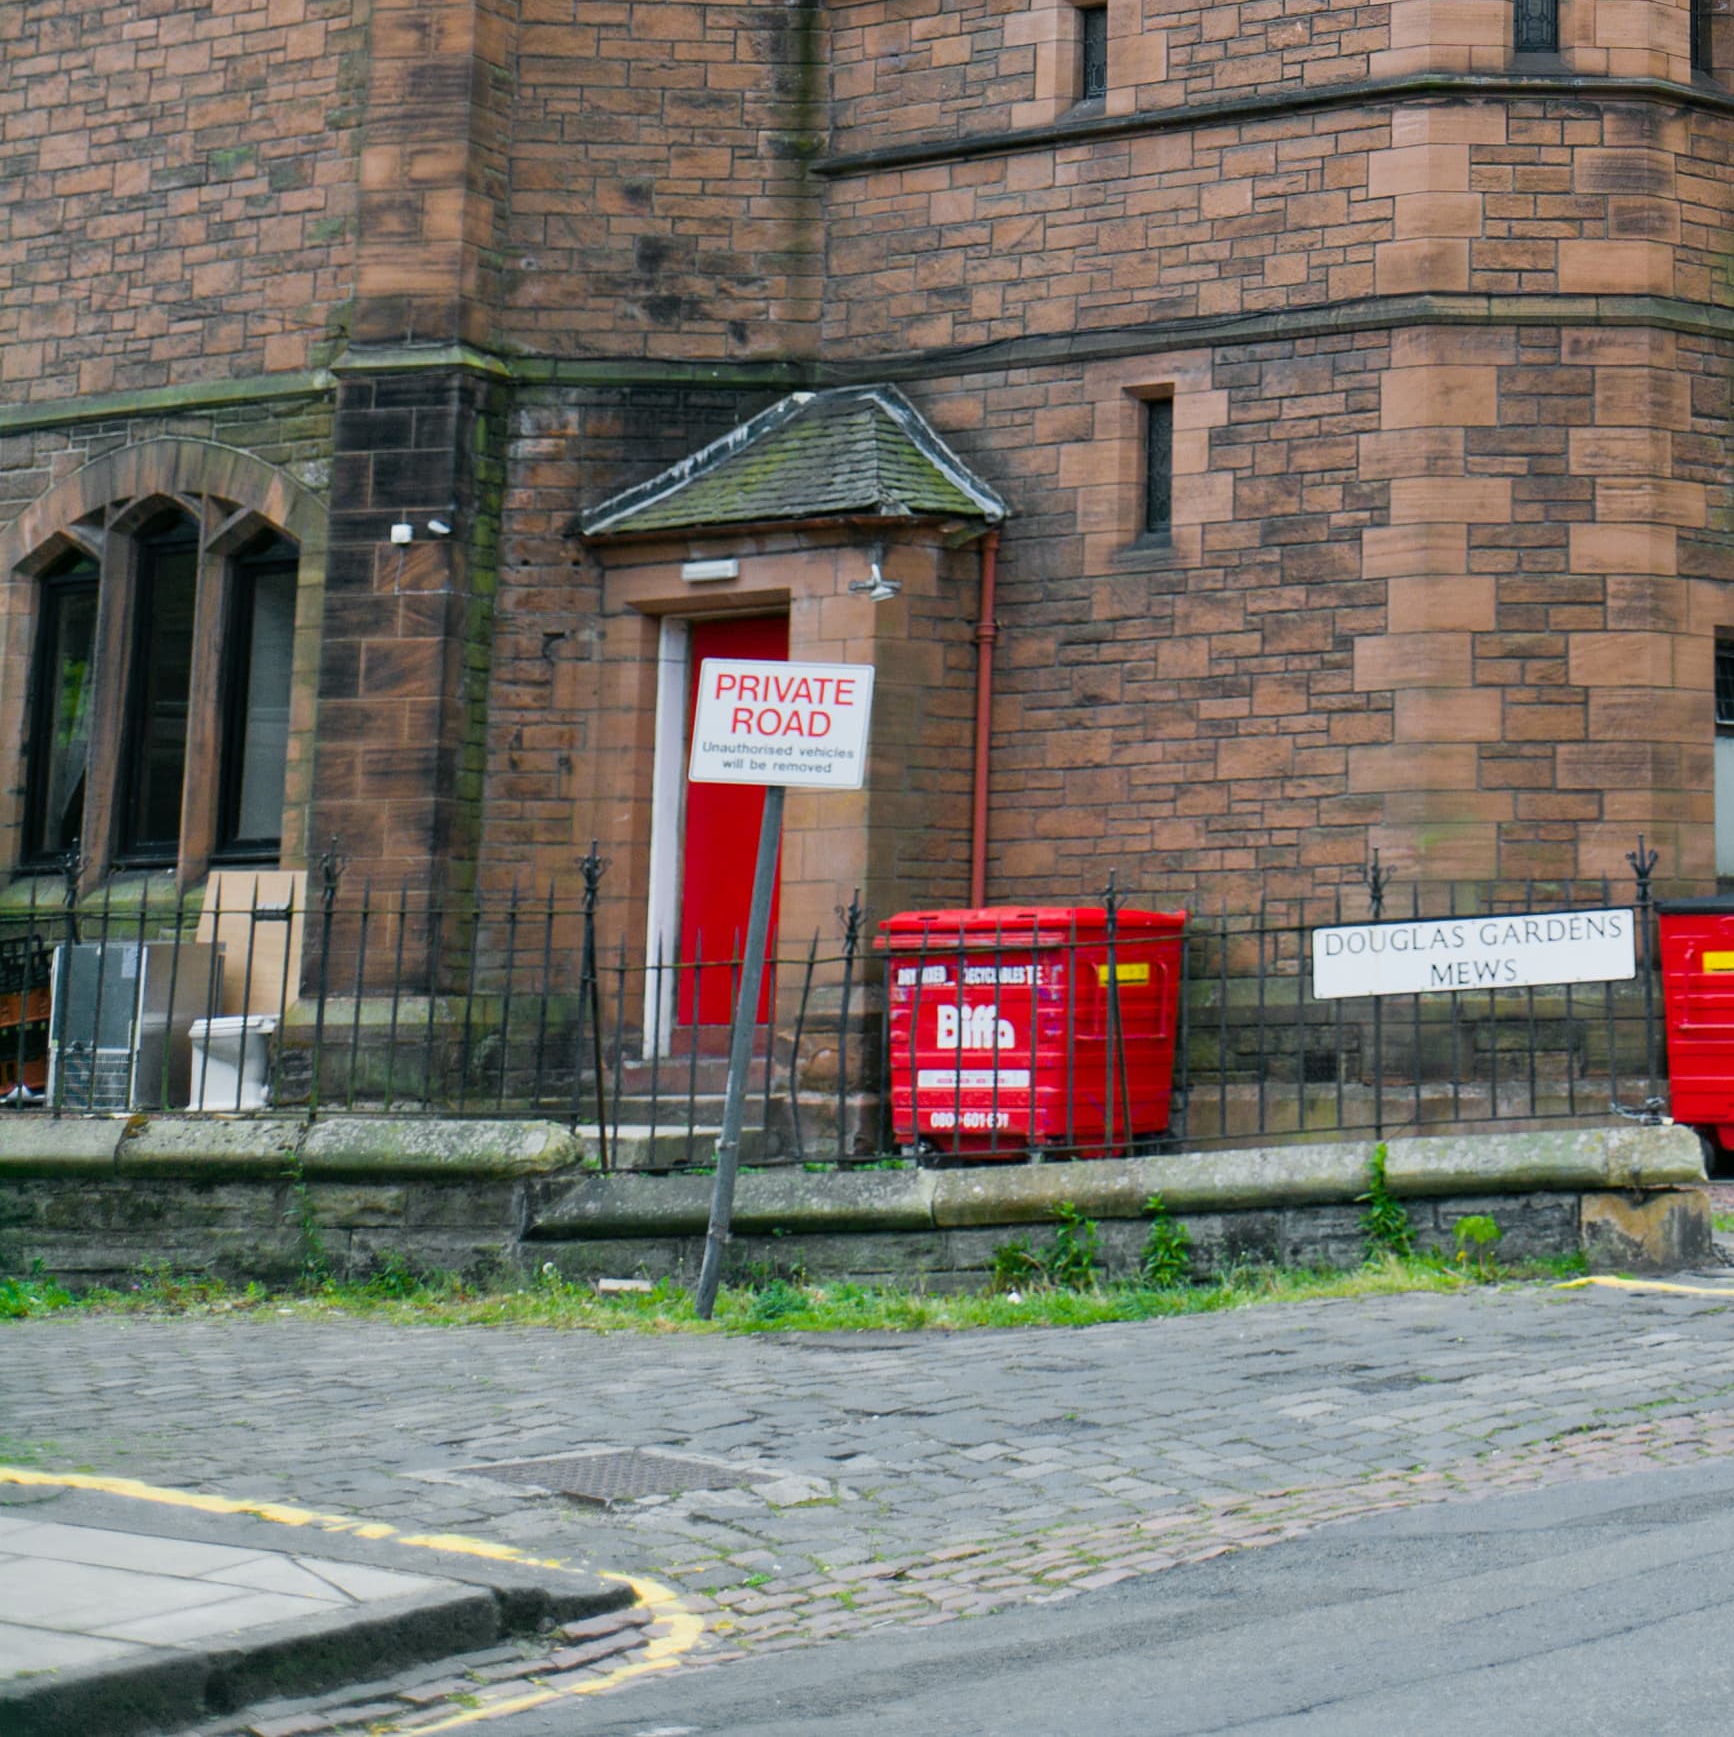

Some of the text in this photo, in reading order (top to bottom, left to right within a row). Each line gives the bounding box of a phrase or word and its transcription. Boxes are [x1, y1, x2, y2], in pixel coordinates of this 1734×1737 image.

[714, 673, 856, 706] PRIVATE
[731, 707, 831, 738] ROAD
[702, 741, 854, 759] Unauthorised vehicles
[722, 759, 832, 774] will be removed
[1325, 915, 1622, 956] DOUGLAS GARDENS
[1431, 959, 1518, 987] MEWS
[937, 1005, 1015, 1049] Biffa
[930, 1112, 1009, 1128] 080-601-601
